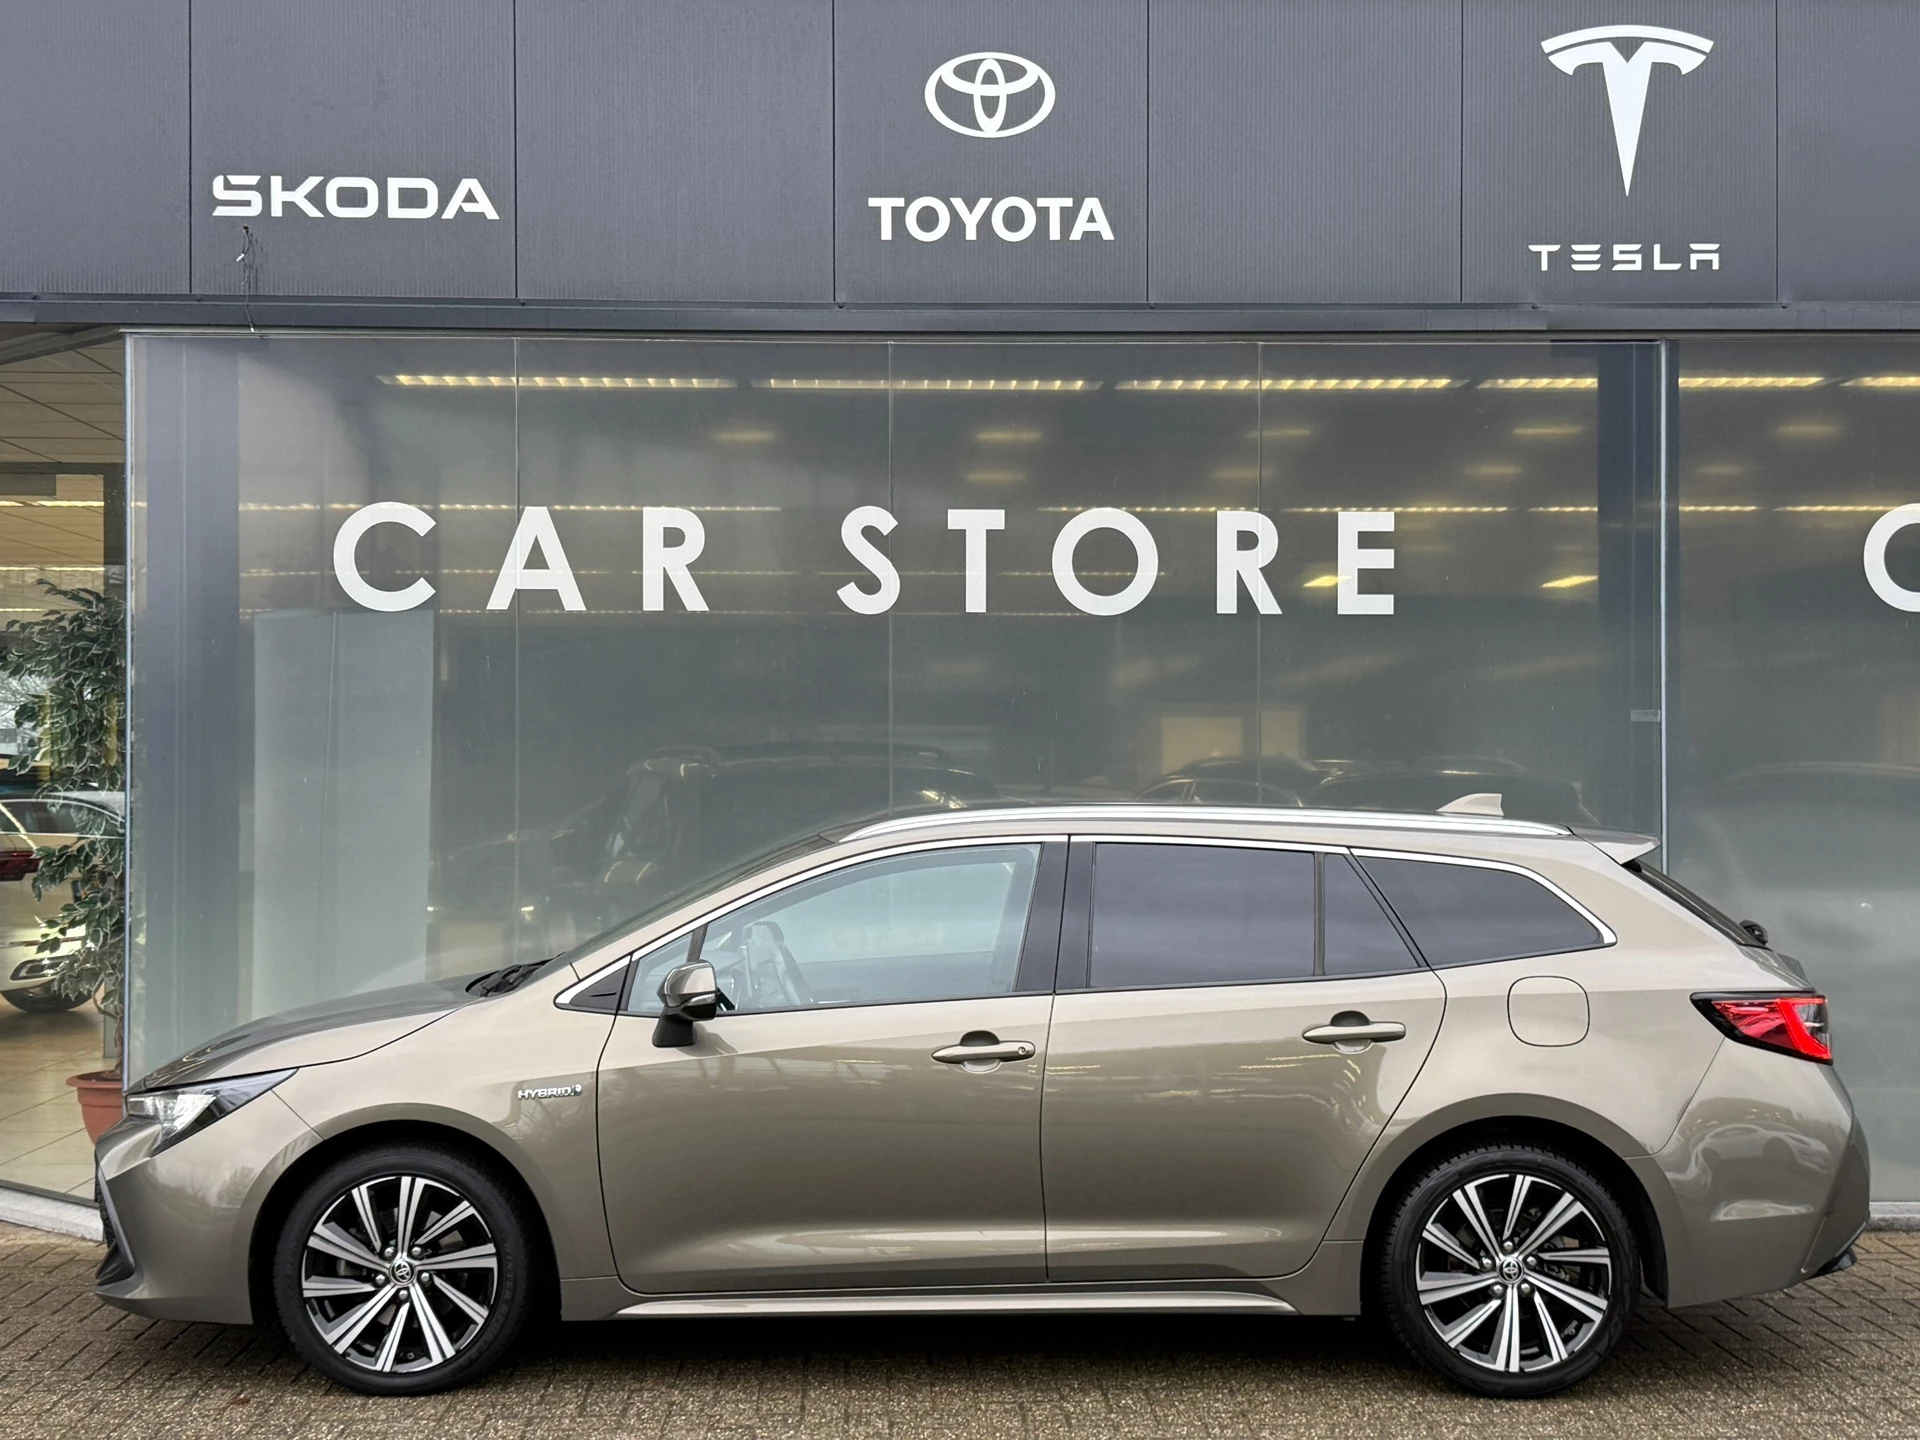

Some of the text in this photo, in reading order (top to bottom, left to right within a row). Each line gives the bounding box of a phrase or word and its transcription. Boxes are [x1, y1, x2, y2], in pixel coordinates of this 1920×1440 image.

[867, 195, 1115, 243] TOYOTA
[1527, 242, 1721, 272] TESLA
[333, 501, 1395, 616] CAR STORE
[517, 1086, 572, 1099] HYBRID
